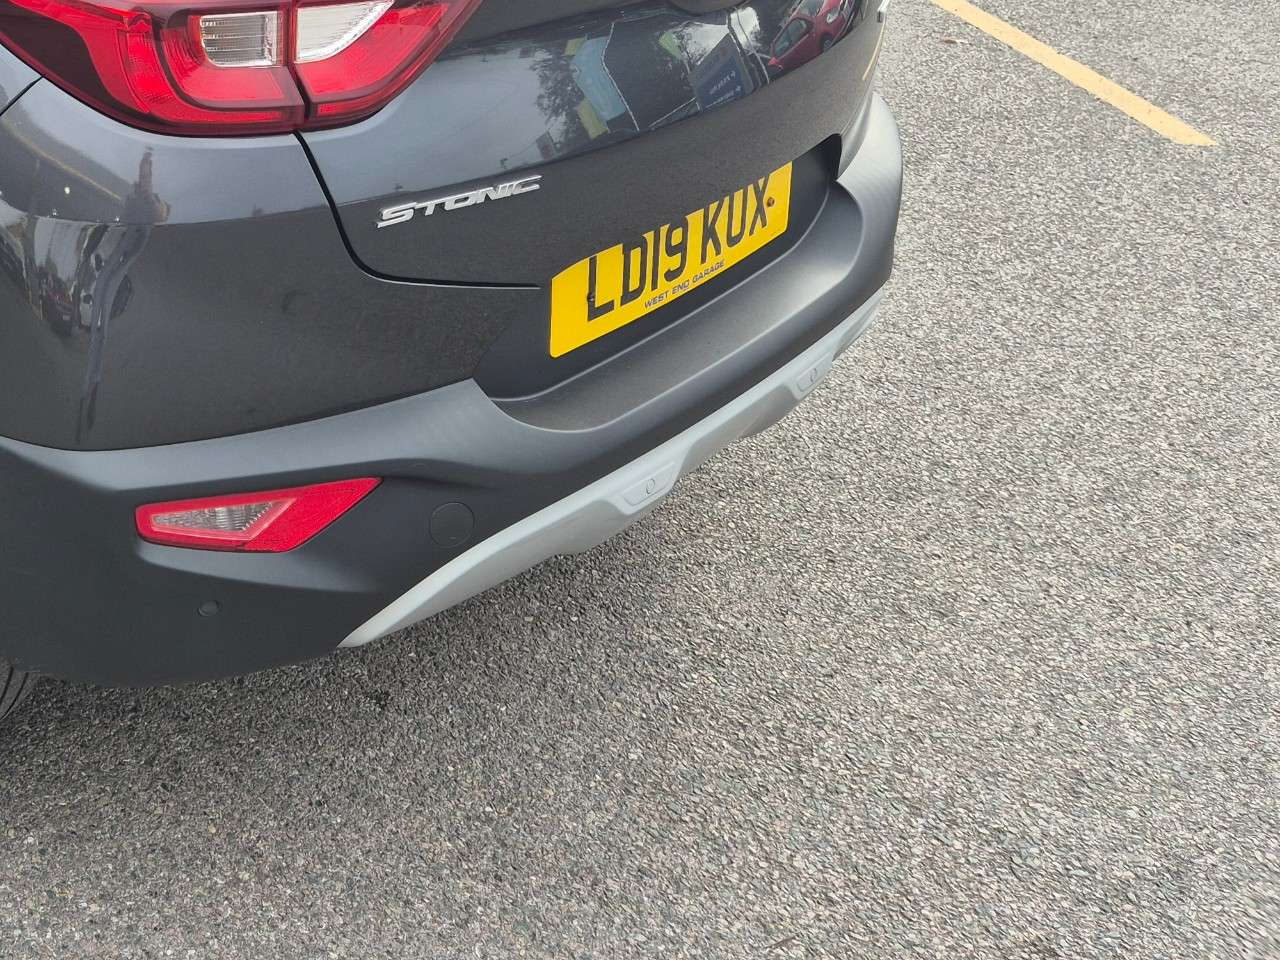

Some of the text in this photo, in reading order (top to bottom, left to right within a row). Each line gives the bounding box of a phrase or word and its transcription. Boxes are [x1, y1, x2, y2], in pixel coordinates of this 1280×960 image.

[377, 174, 543, 228] STONIC
[587, 175, 770, 322] LD19 KUX
[644, 259, 725, 309] WEST END GARAGE
